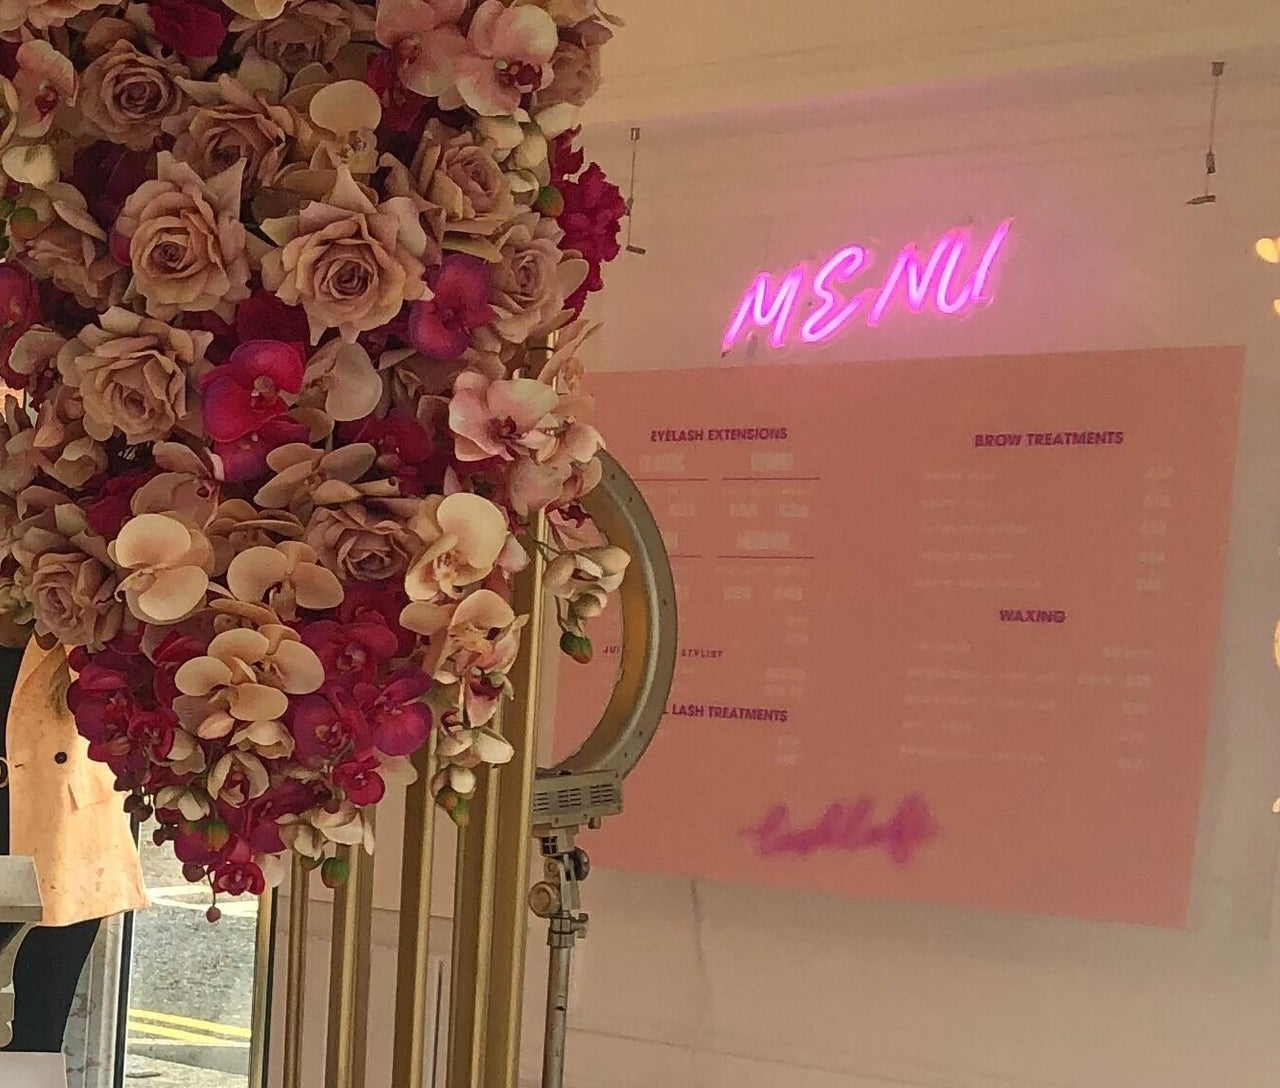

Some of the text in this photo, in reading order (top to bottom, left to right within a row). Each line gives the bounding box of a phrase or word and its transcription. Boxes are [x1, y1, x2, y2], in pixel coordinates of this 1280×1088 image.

[722, 217, 1013, 356] MENU
[650, 427, 788, 442] EYELASH EXTENSIONS
[974, 430, 1124, 448] BROW TREATMENTS
[999, 609, 1067, 624] WAXING
[671, 703, 788, 723] LASH TREATMENTS
